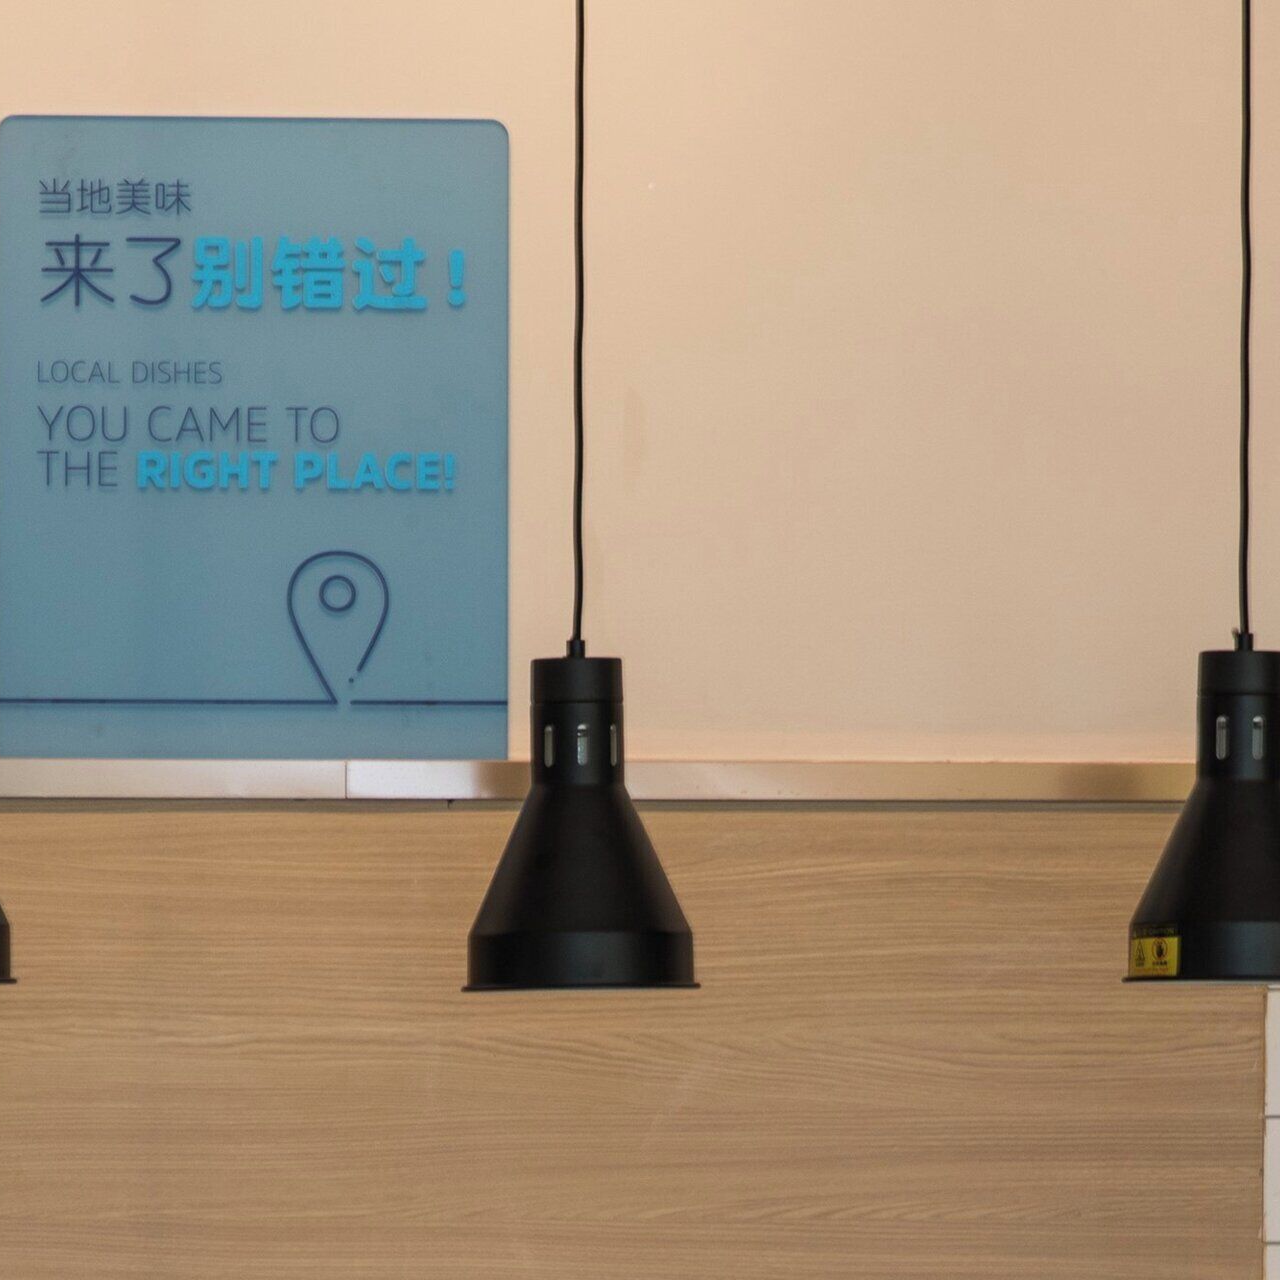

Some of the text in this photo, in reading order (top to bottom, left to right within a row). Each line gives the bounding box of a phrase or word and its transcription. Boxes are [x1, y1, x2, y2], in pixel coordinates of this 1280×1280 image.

[39, 178, 191, 216] 当地美味
[40, 233, 467, 311] 来了别错过！
[37, 360, 223, 385] LOCAL DISHES
[37, 405, 340, 443] YOU CAME TO
[37, 450, 456, 490] THE RIGHT PLACE!
